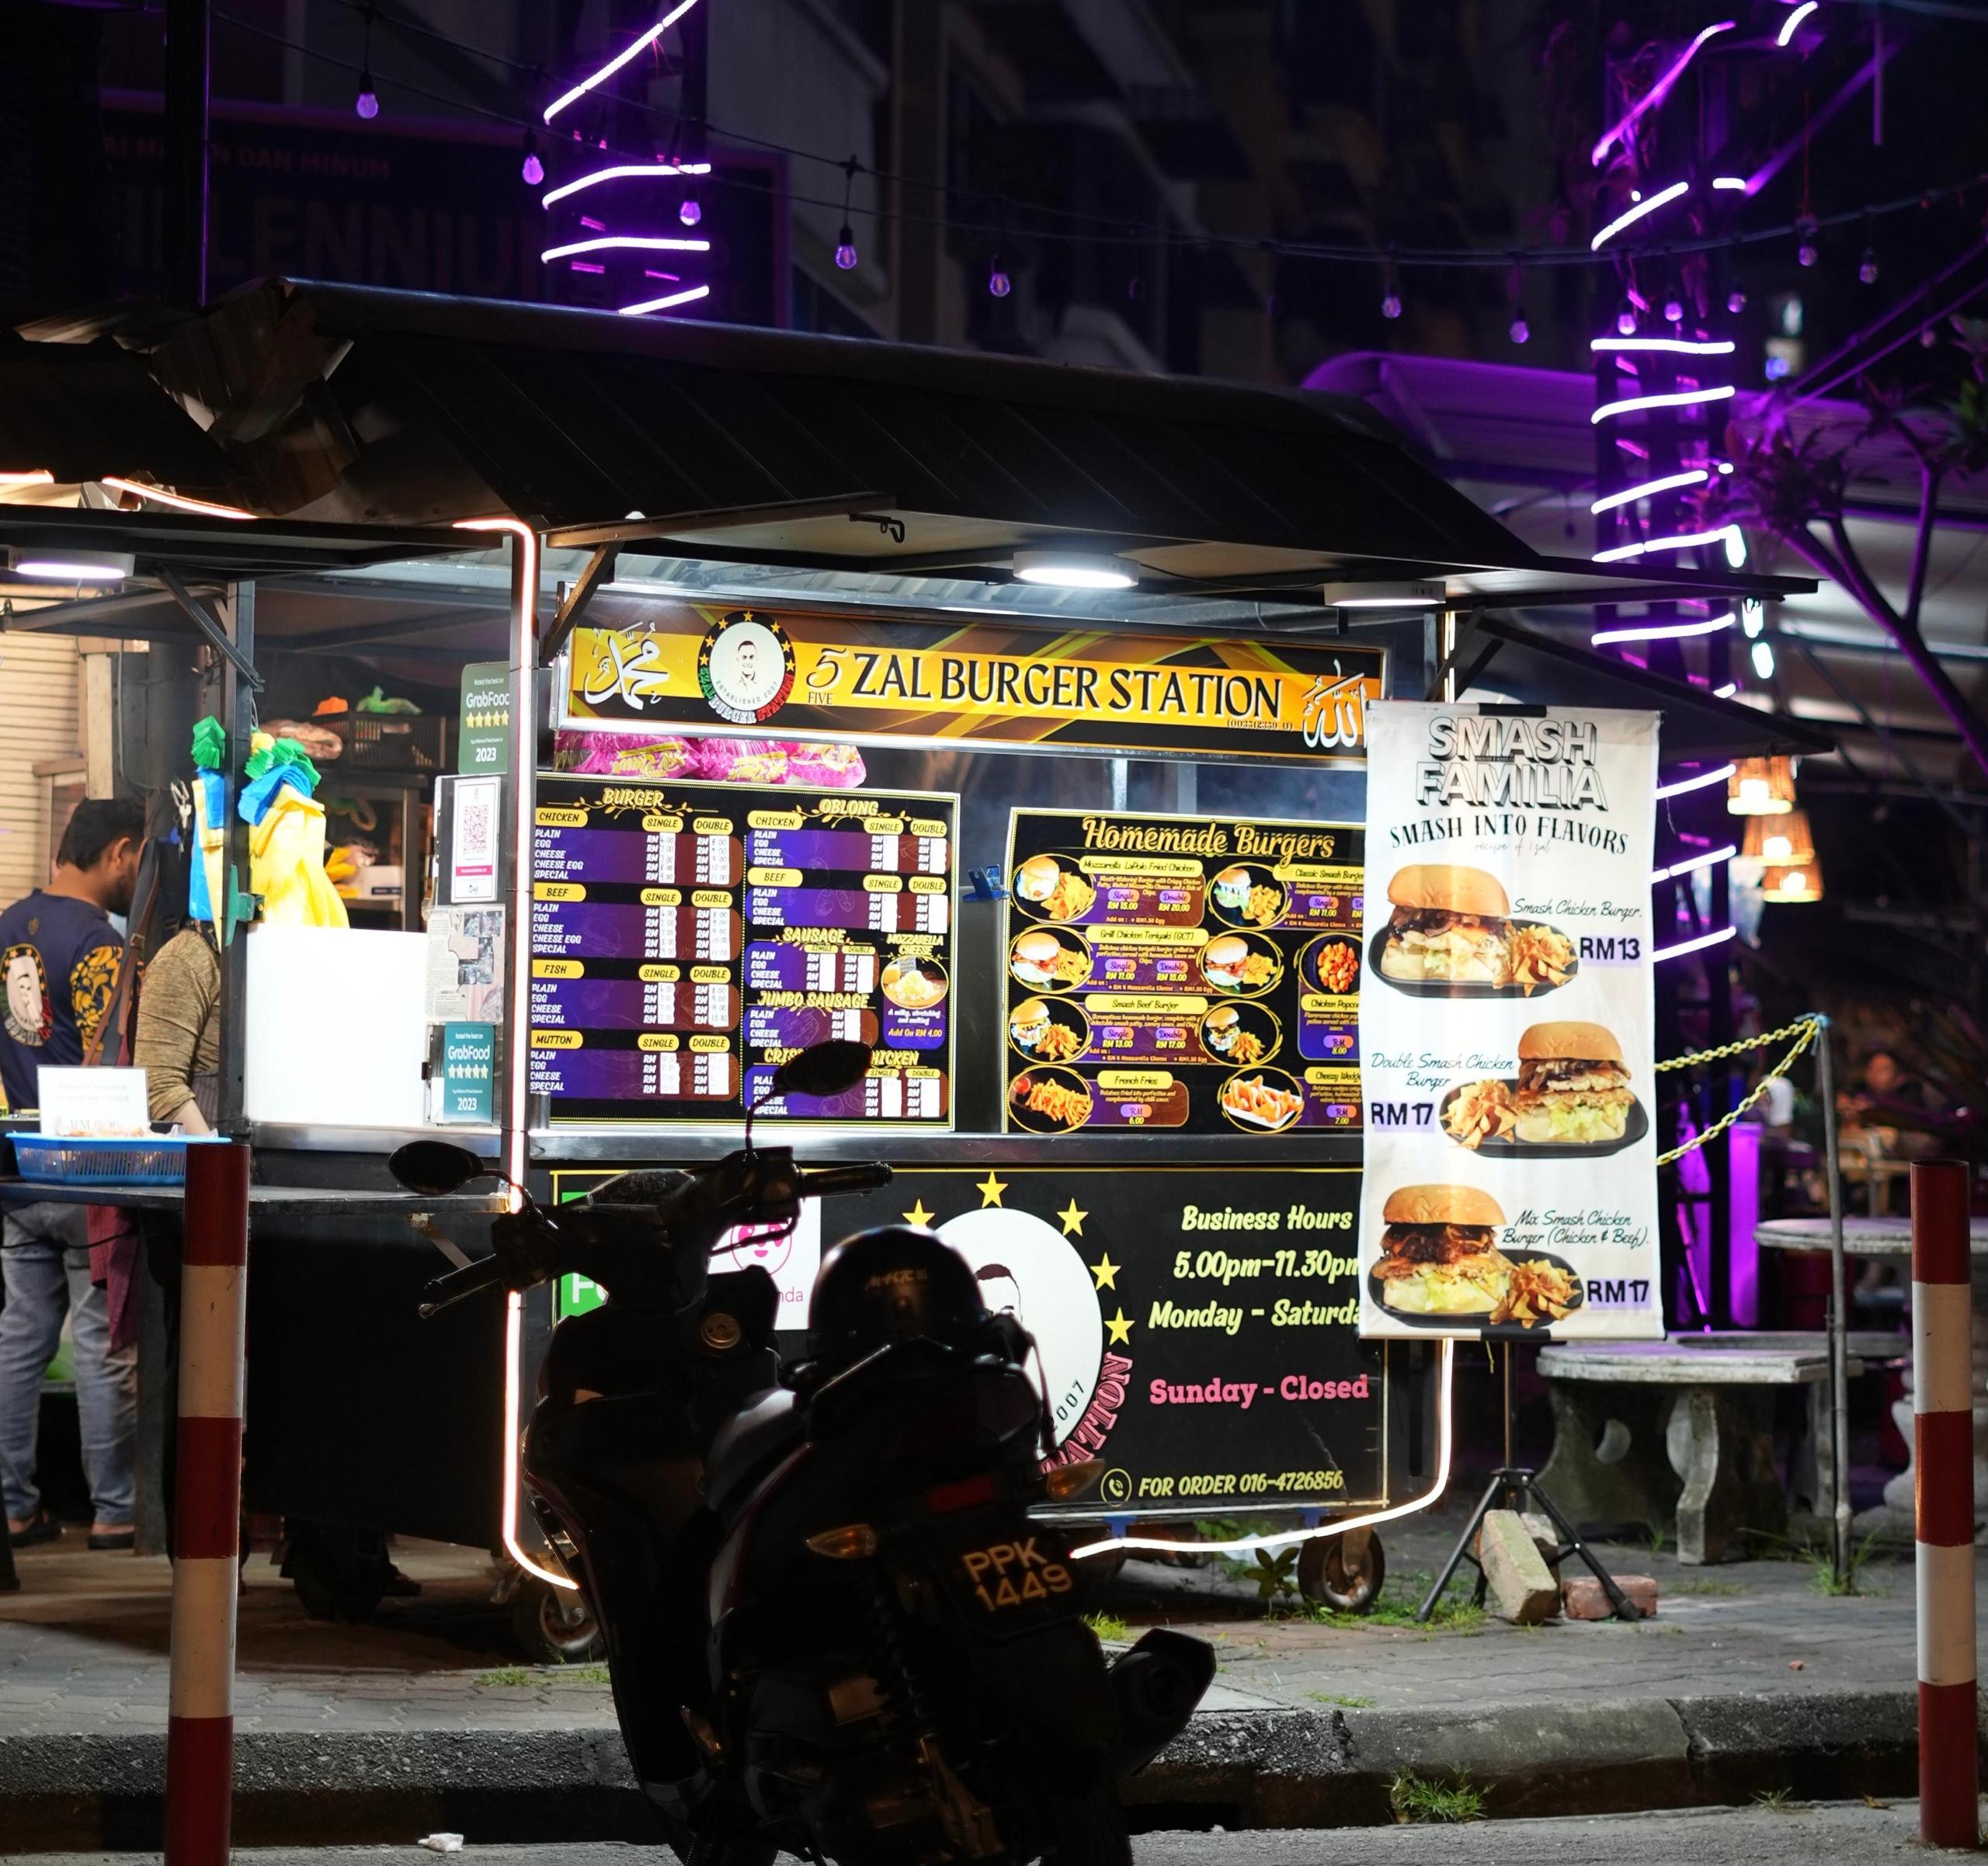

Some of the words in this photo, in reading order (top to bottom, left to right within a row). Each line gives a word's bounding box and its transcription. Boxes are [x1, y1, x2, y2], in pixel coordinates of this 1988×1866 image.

[806, 647, 849, 689] 5
[853, 652, 931, 698] ZAL
[940, 657, 1100, 710] BURGER
[1110, 669, 1282, 719] STATION
[715, 680, 762, 705] ESTABLISHED
[764, 681, 779, 699] 2007
[708, 695, 756, 724] BURGER
[756, 672, 794, 721] STATION
[808, 691, 833, 706] FIVE
[1429, 716, 1597, 766] SMASH
[475, 747, 497, 763] 2023
[1416, 762, 1608, 811] FAMILIA
[603, 787, 664, 807] BURGER
[819, 799, 879, 815] OBLONG
[539, 812, 579, 822] CHICKEN
[756, 818, 795, 826] CHICKEN
[697, 821, 730, 830] DOUBLE
[869, 823, 898, 832] SINGLE
[912, 825, 945, 833] DOUBLE
[535, 829, 561, 838] PLAIN
[1390, 817, 1463, 849] SMASH
[1475, 814, 1527, 836] INTO
[1538, 816, 1628, 854] FLAVORS
[535, 839, 551, 848] EGG
[1083, 818, 1227, 855] Homemade
[1234, 824, 1335, 868] Burgers
[535, 850, 565, 859] CHEESE
[535, 860, 565, 869] CHEESE
[1169, 864, 1195, 872] Chicken
[534, 870, 568, 879] SPECIAL
[764, 873, 786, 881] BEEF
[868, 880, 898, 888] SINGLE
[913, 881, 944, 890] DOUBLE
[547, 888, 568, 897] BEEF
[1113, 891, 1134, 901] Single
[1163, 892, 1187, 902] Double
[695, 894, 728, 902] DOUBLE
[1315, 899, 1334, 908] Single
[1514, 898, 1552, 914] Smash
[1555, 901, 1597, 916] Chicken
[1600, 902, 1642, 921] Burger.
[533, 913, 549, 922] EGG
[533, 923, 564, 933] CHEESE
[533, 933, 564, 943] CHEESE
[565, 935, 581, 943] EGG
[783, 927, 846, 943] SAUSAGE
[887, 934, 944, 945] MOZZARELLA
[1117, 930, 1142, 939] Chicken
[533, 944, 567, 953] SPECIAL
[898, 945, 933, 954] CHEESE
[1110, 961, 1131, 971] Single
[1162, 962, 1184, 971] Double
[693, 970, 726, 978] DOUBLE
[532, 994, 547, 1002] EGG
[757, 991, 803, 1007] JUMBO
[806, 992, 870, 1009] SAUSAGE
[1155, 1002, 1179, 1011] Burger
[1311, 999, 1336, 1008] Chicken
[532, 1005, 561, 1013] CHEESE
[531, 1015, 565, 1023] SPECIAL
[1108, 1029, 1129, 1038] Single
[1159, 1030, 1183, 1038] Double
[448, 1044, 490, 1060] GrabFood
[764, 1048, 805, 1062] CRIS
[872, 1051, 919, 1065] HICKEN
[1371, 1052, 1413, 1069] Double
[1418, 1054, 1461, 1069] Smash
[1465, 1055, 1514, 1070] Chicken
[1115, 1075, 1139, 1085] French
[1406, 1071, 1451, 1092] Burger
[457, 1097, 477, 1111] 2023
[1181, 1204, 1280, 1231] Business
[1287, 1204, 1353, 1230] Hours
[1542, 1211, 1583, 1225] Smash
[1587, 1210, 1632, 1225] Chicken
[1503, 1229, 1545, 1249] Burger
[1548, 1226, 1598, 1245] (Chicken
[1149, 1300, 1242, 1336] Monday
[1271, 1298, 1360, 1327] Saturda
[1149, 1378, 1258, 1409] Sunday
[1281, 1374, 1368, 1401] Closed
[1138, 1477, 1175, 1497] FOR
[1178, 1474, 1235, 1496] ORDER
[1239, 1469, 1343, 1493] 016-4726856
[961, 1536, 1048, 1583] PPK
[975, 1563, 1072, 1613] 1449
